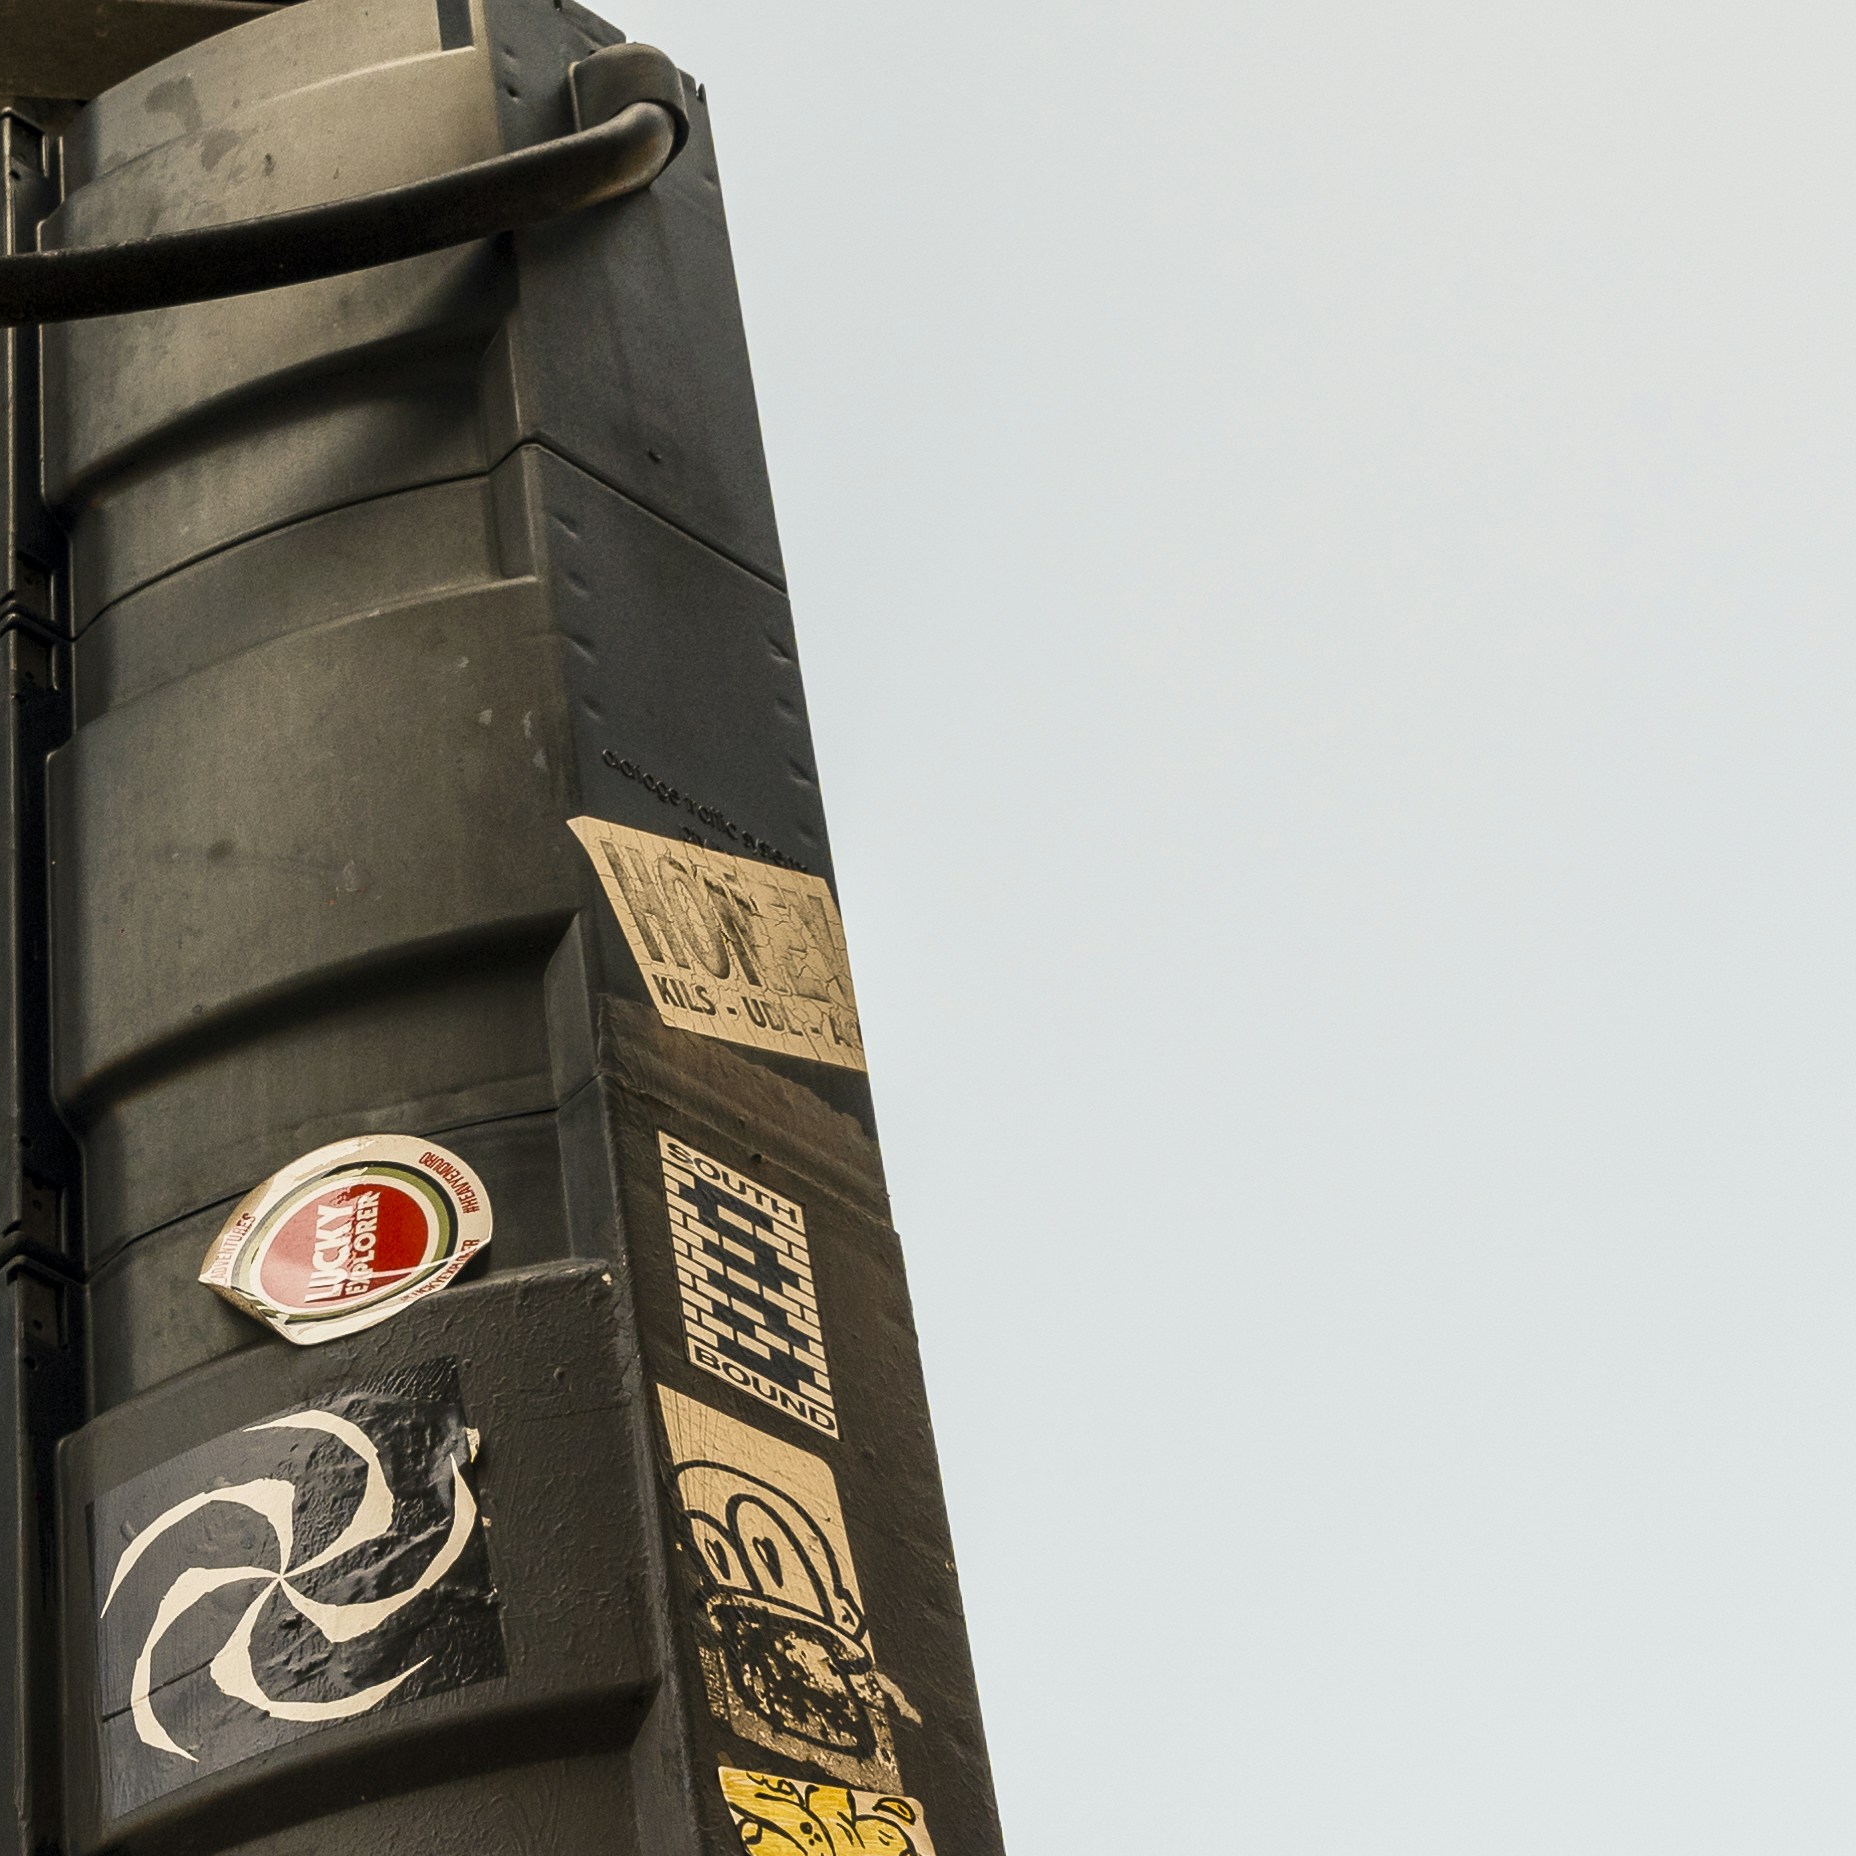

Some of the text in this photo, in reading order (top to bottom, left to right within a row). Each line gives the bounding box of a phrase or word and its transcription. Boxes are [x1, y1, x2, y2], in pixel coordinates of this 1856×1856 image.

[651, 973, 717, 1017] KILS
[418, 1151, 480, 1214] #HEAVYENDURO
[666, 1142, 798, 1225] SOUTH
[211, 1212, 256, 1284] ADVENTURES
[304, 1204, 354, 1304] LUCKY
[344, 1191, 381, 1296] EXPLORER
[695, 1345, 837, 1432] BOUND
